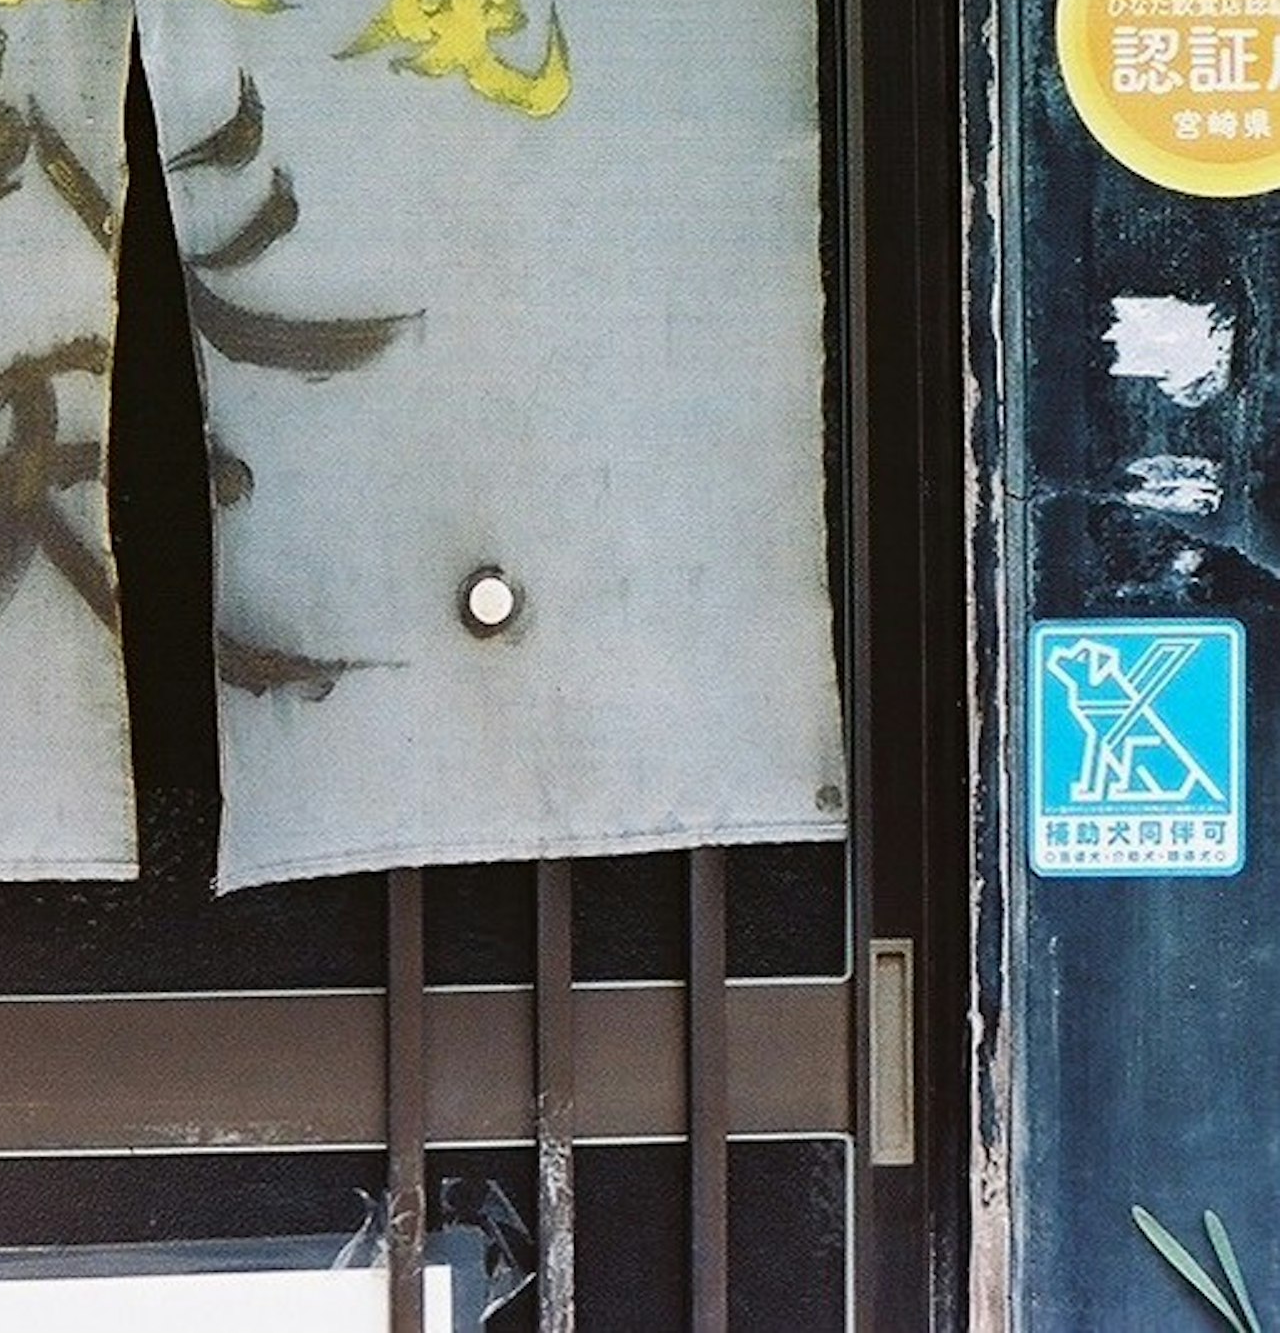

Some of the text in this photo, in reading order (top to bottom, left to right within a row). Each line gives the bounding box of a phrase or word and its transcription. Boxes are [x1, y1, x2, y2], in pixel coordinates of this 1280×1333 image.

[1111, 25, 1280, 94] 認証
[1173, 108, 1272, 141] 宮崎県
[1045, 821, 1227, 847] 補助犬同伴可
